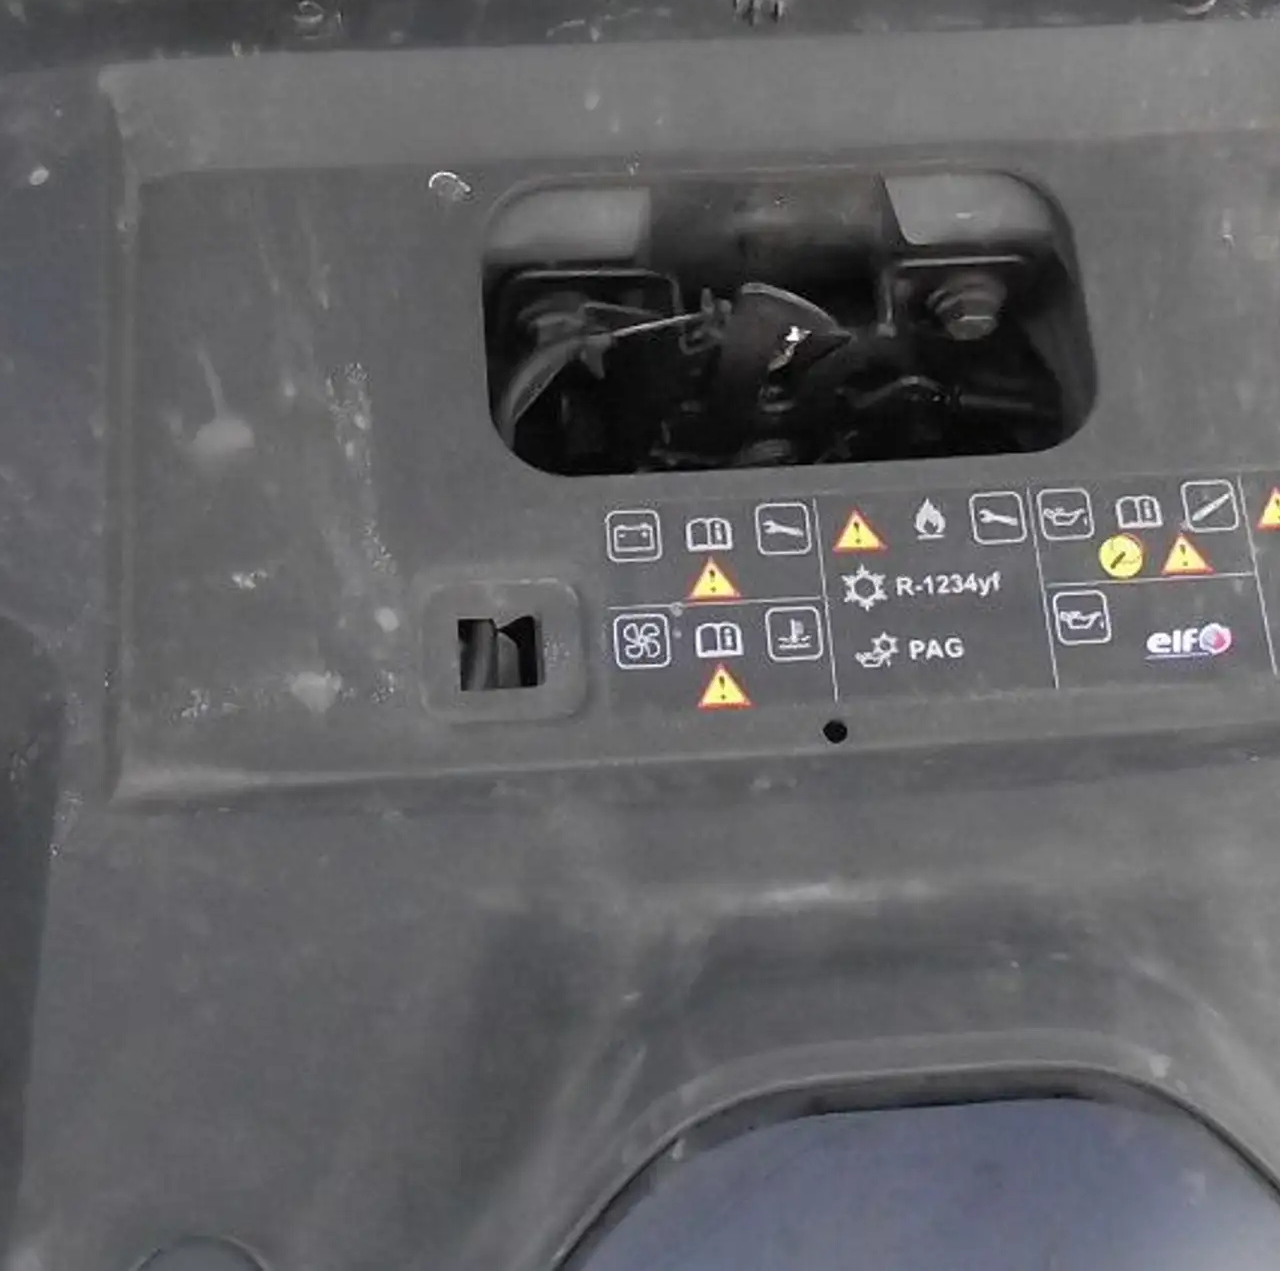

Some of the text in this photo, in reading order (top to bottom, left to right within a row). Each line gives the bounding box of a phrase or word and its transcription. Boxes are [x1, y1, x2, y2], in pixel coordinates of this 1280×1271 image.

[895, 570, 1001, 597] R-1234yf
[908, 636, 965, 661] PAG
[1146, 627, 1199, 654] elf
